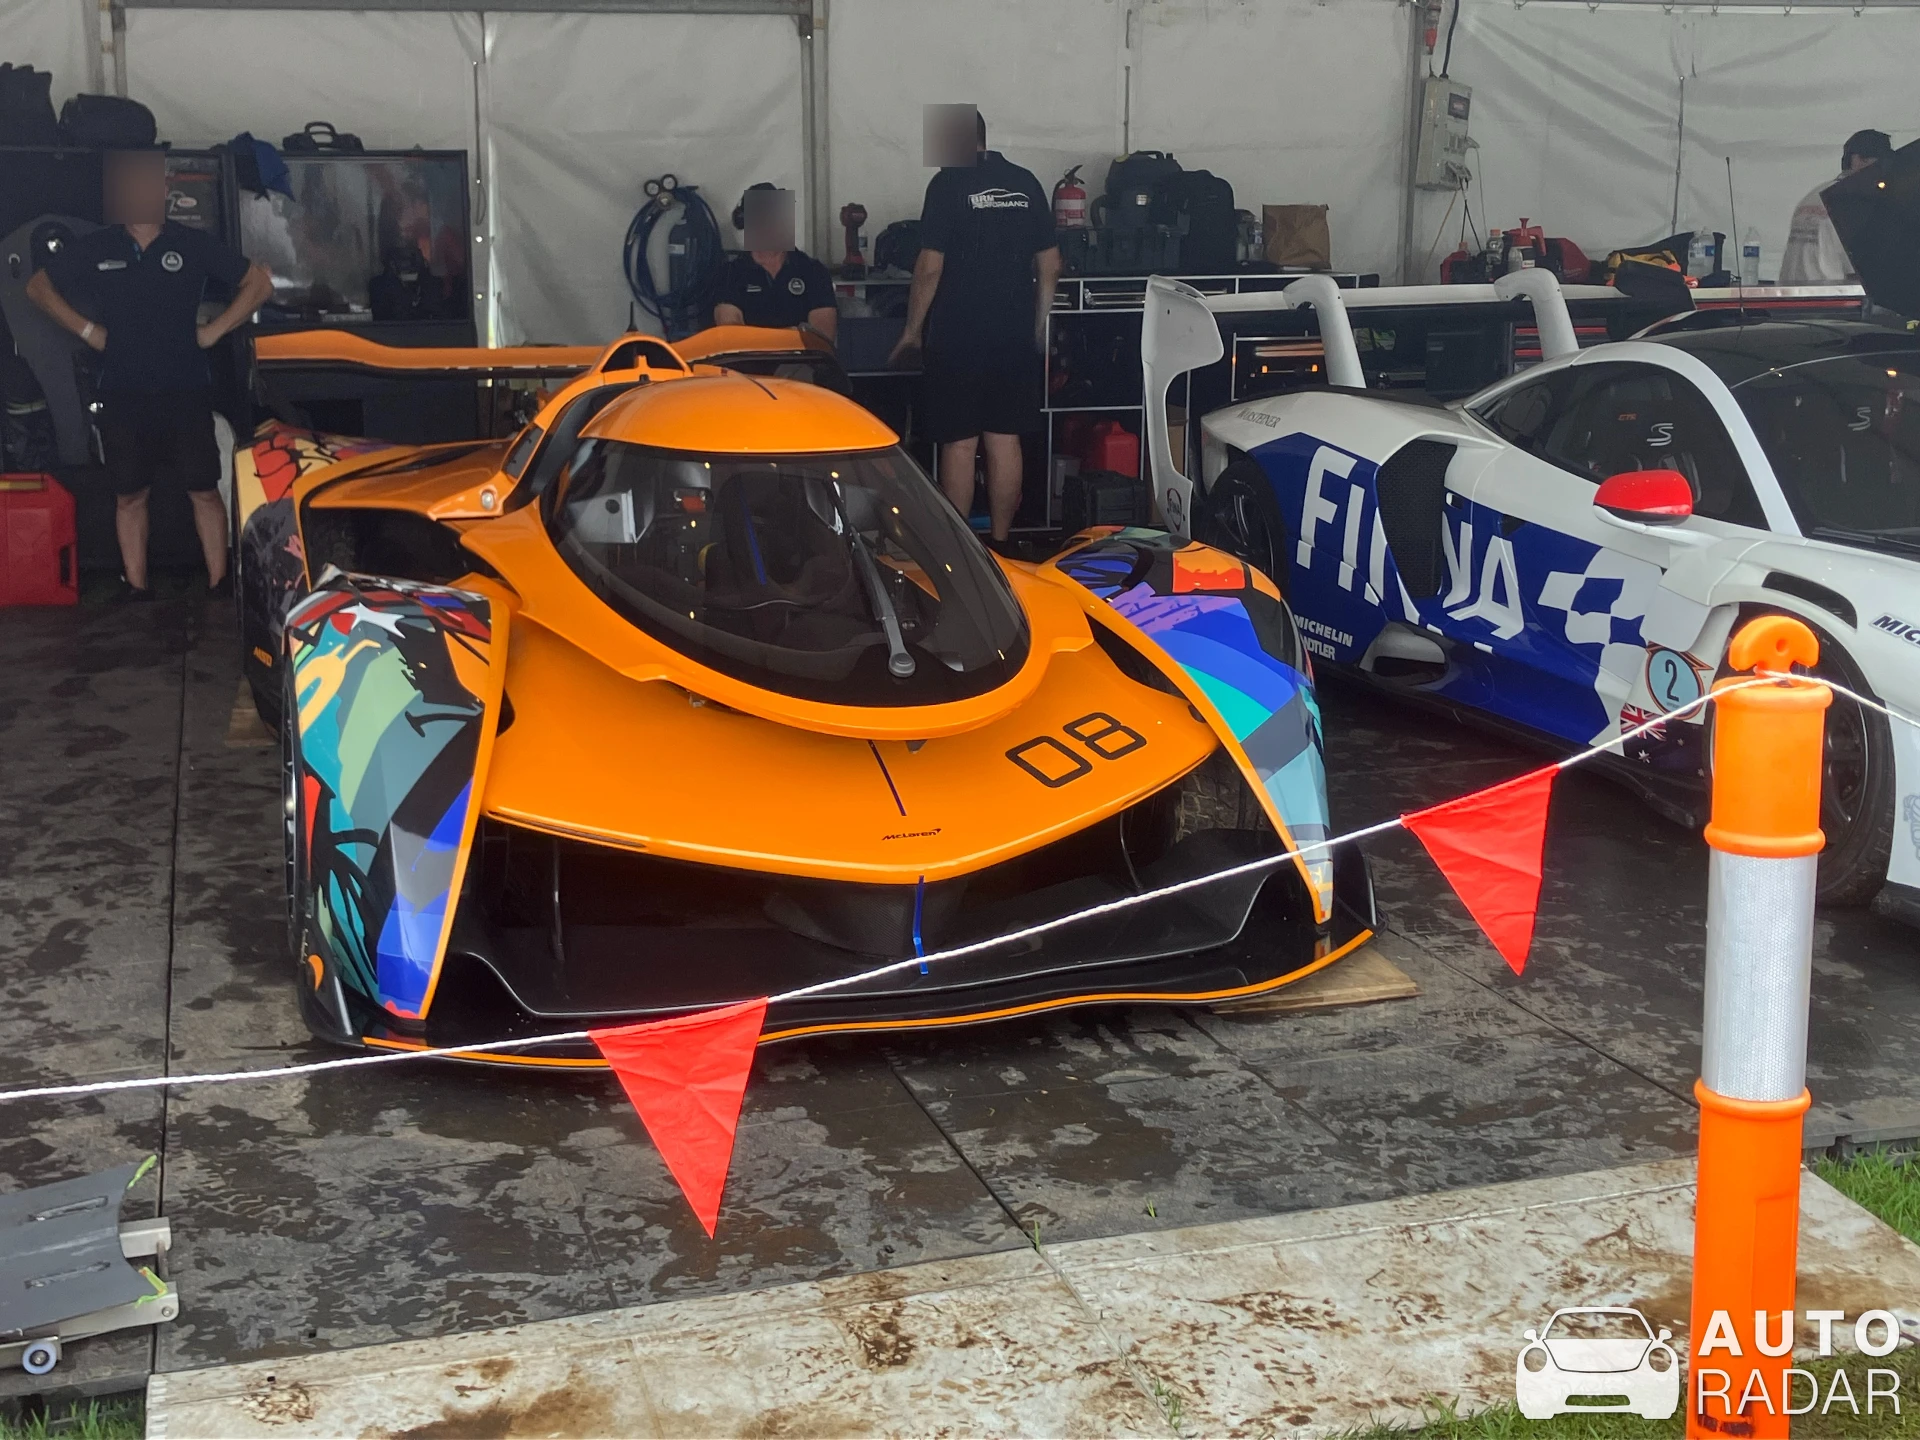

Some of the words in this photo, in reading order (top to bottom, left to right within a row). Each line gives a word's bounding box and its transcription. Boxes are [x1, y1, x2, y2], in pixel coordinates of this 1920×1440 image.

[972, 200, 1029, 209] PERFORMANCE
[1294, 614, 1353, 648] MICHELIN
[1872, 615, 1920, 646] MIC
[1665, 659, 1680, 702] 2
[1005, 712, 1147, 788] 08
[881, 830, 938, 840] McLaren
